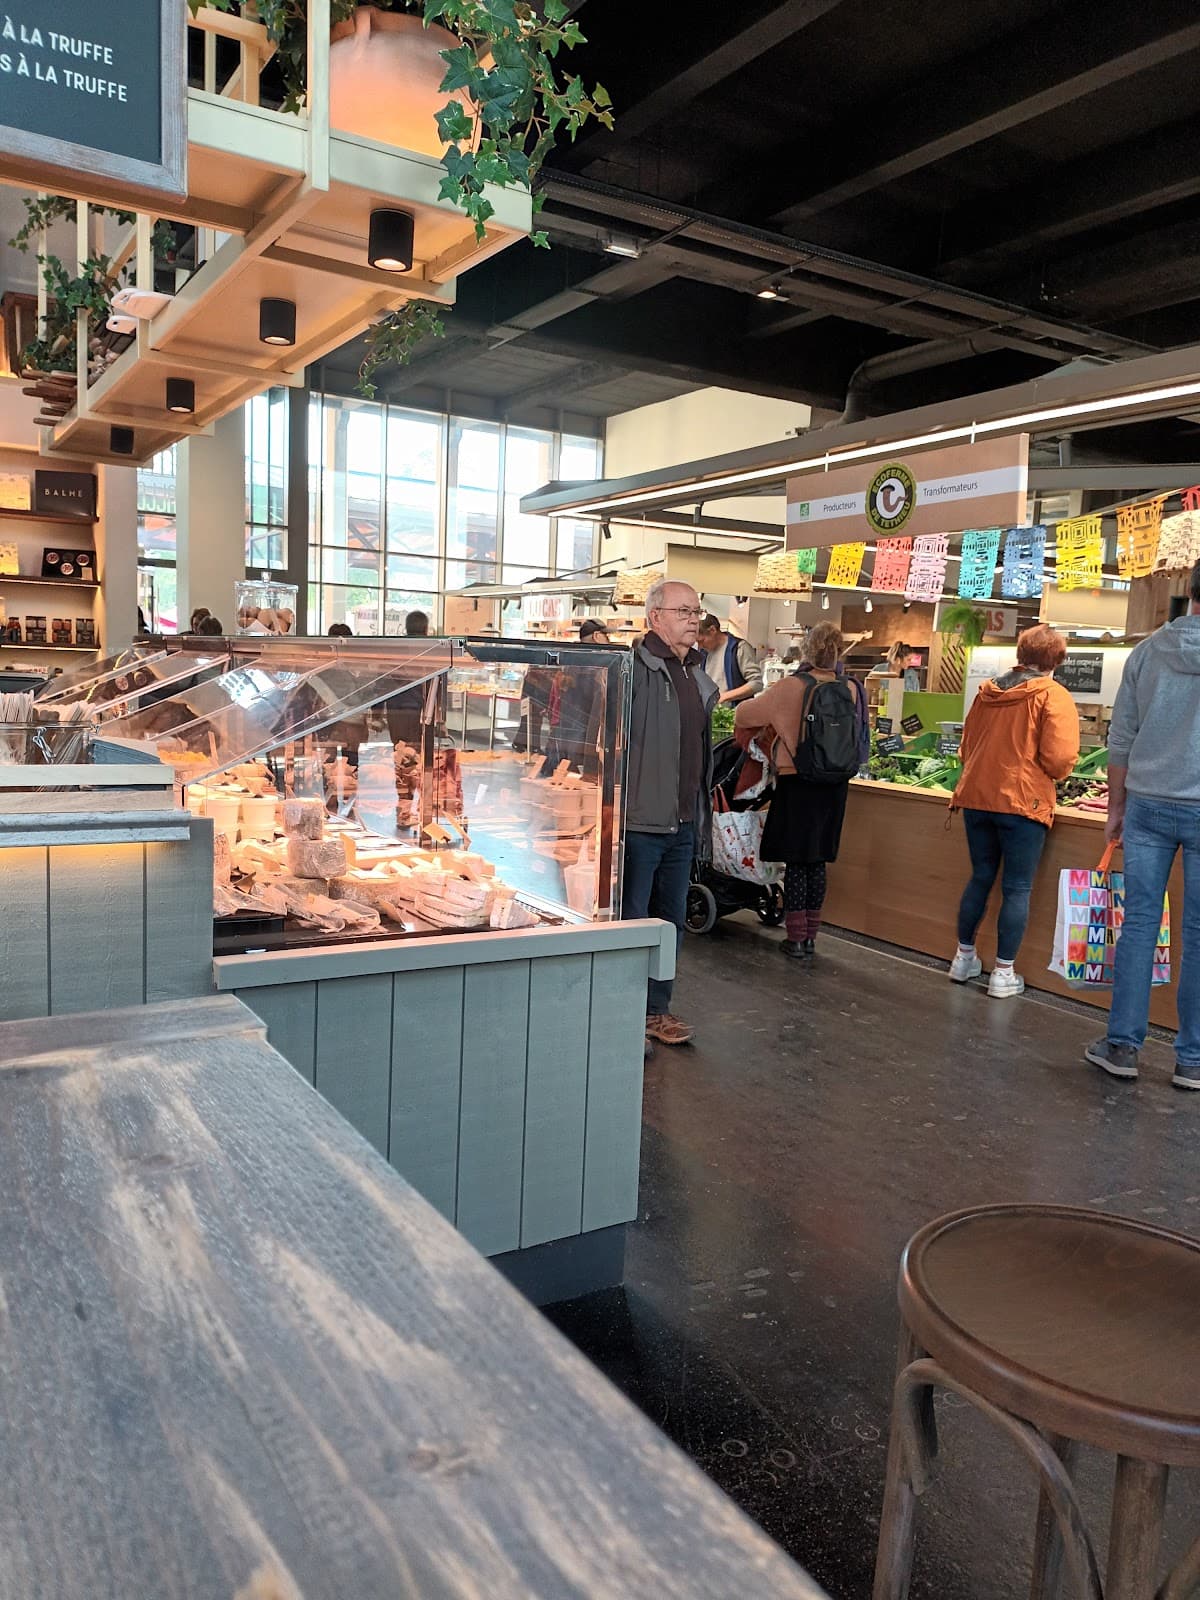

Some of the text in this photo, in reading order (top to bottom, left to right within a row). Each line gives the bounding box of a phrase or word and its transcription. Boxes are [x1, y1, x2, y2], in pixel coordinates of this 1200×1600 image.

[2, 15, 113, 66] À LA TRUFFE
[17, 52, 30, 77] À
[35, 62, 58, 84] LA
[63, 69, 128, 102] TRUFFE
[923, 482, 978, 497] Transformateurs
[823, 501, 857, 513] Producteurs
